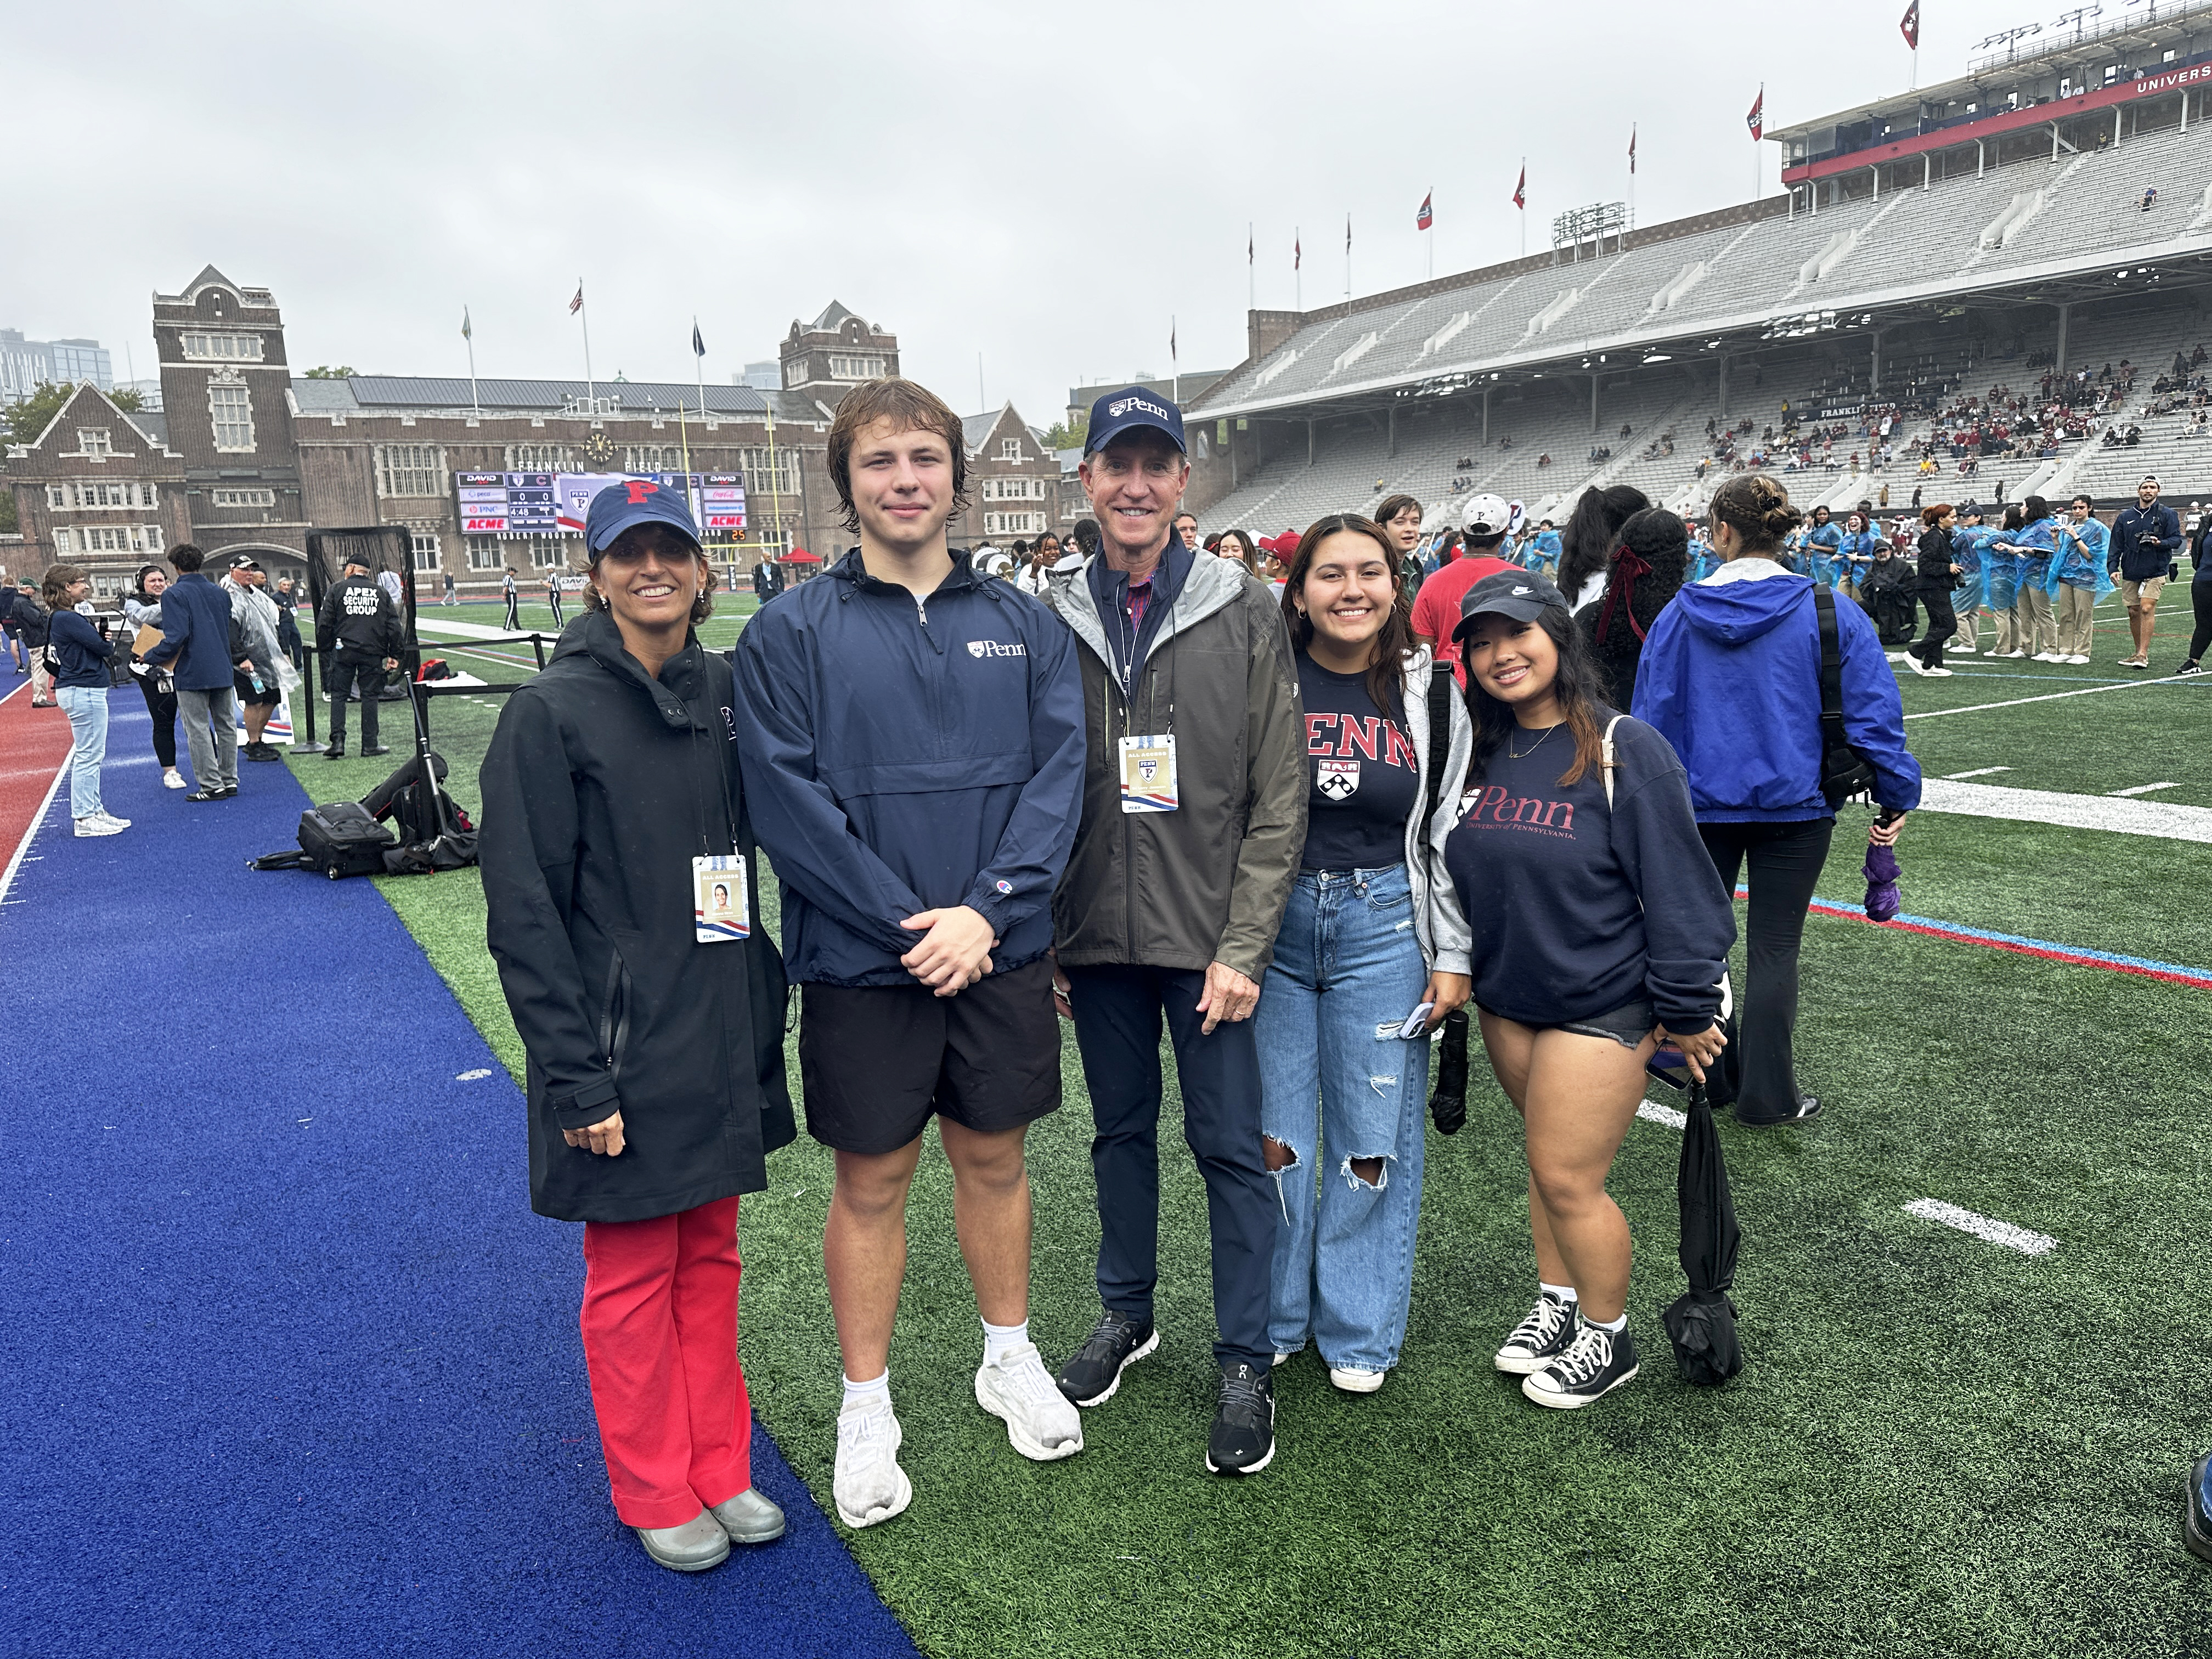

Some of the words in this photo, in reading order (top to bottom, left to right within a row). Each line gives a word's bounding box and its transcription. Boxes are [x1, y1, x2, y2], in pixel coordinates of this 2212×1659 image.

[2137, 66, 2211, 93] UNIVERS
[1126, 397, 1169, 421] Penn
[1821, 404, 1863, 417] FRANKLI
[518, 461, 584, 472] FRANKLIN
[625, 461, 661, 472] FIELD
[520, 493, 526, 501] 0
[543, 493, 549, 501] 0
[624, 481, 659, 504] P
[511, 508, 529, 516] 4:48
[467, 519, 505, 530] ACME
[710, 516, 742, 526] ACME
[731, 529, 746, 540] 25
[345, 586, 377, 598] APEX
[343, 596, 380, 607] SECURITY
[346, 605, 377, 616] GROUP
[983, 640, 1026, 657] Penn
[1468, 786, 1575, 830] Penn
[1466, 822, 1504, 830] UNIVERSITY
